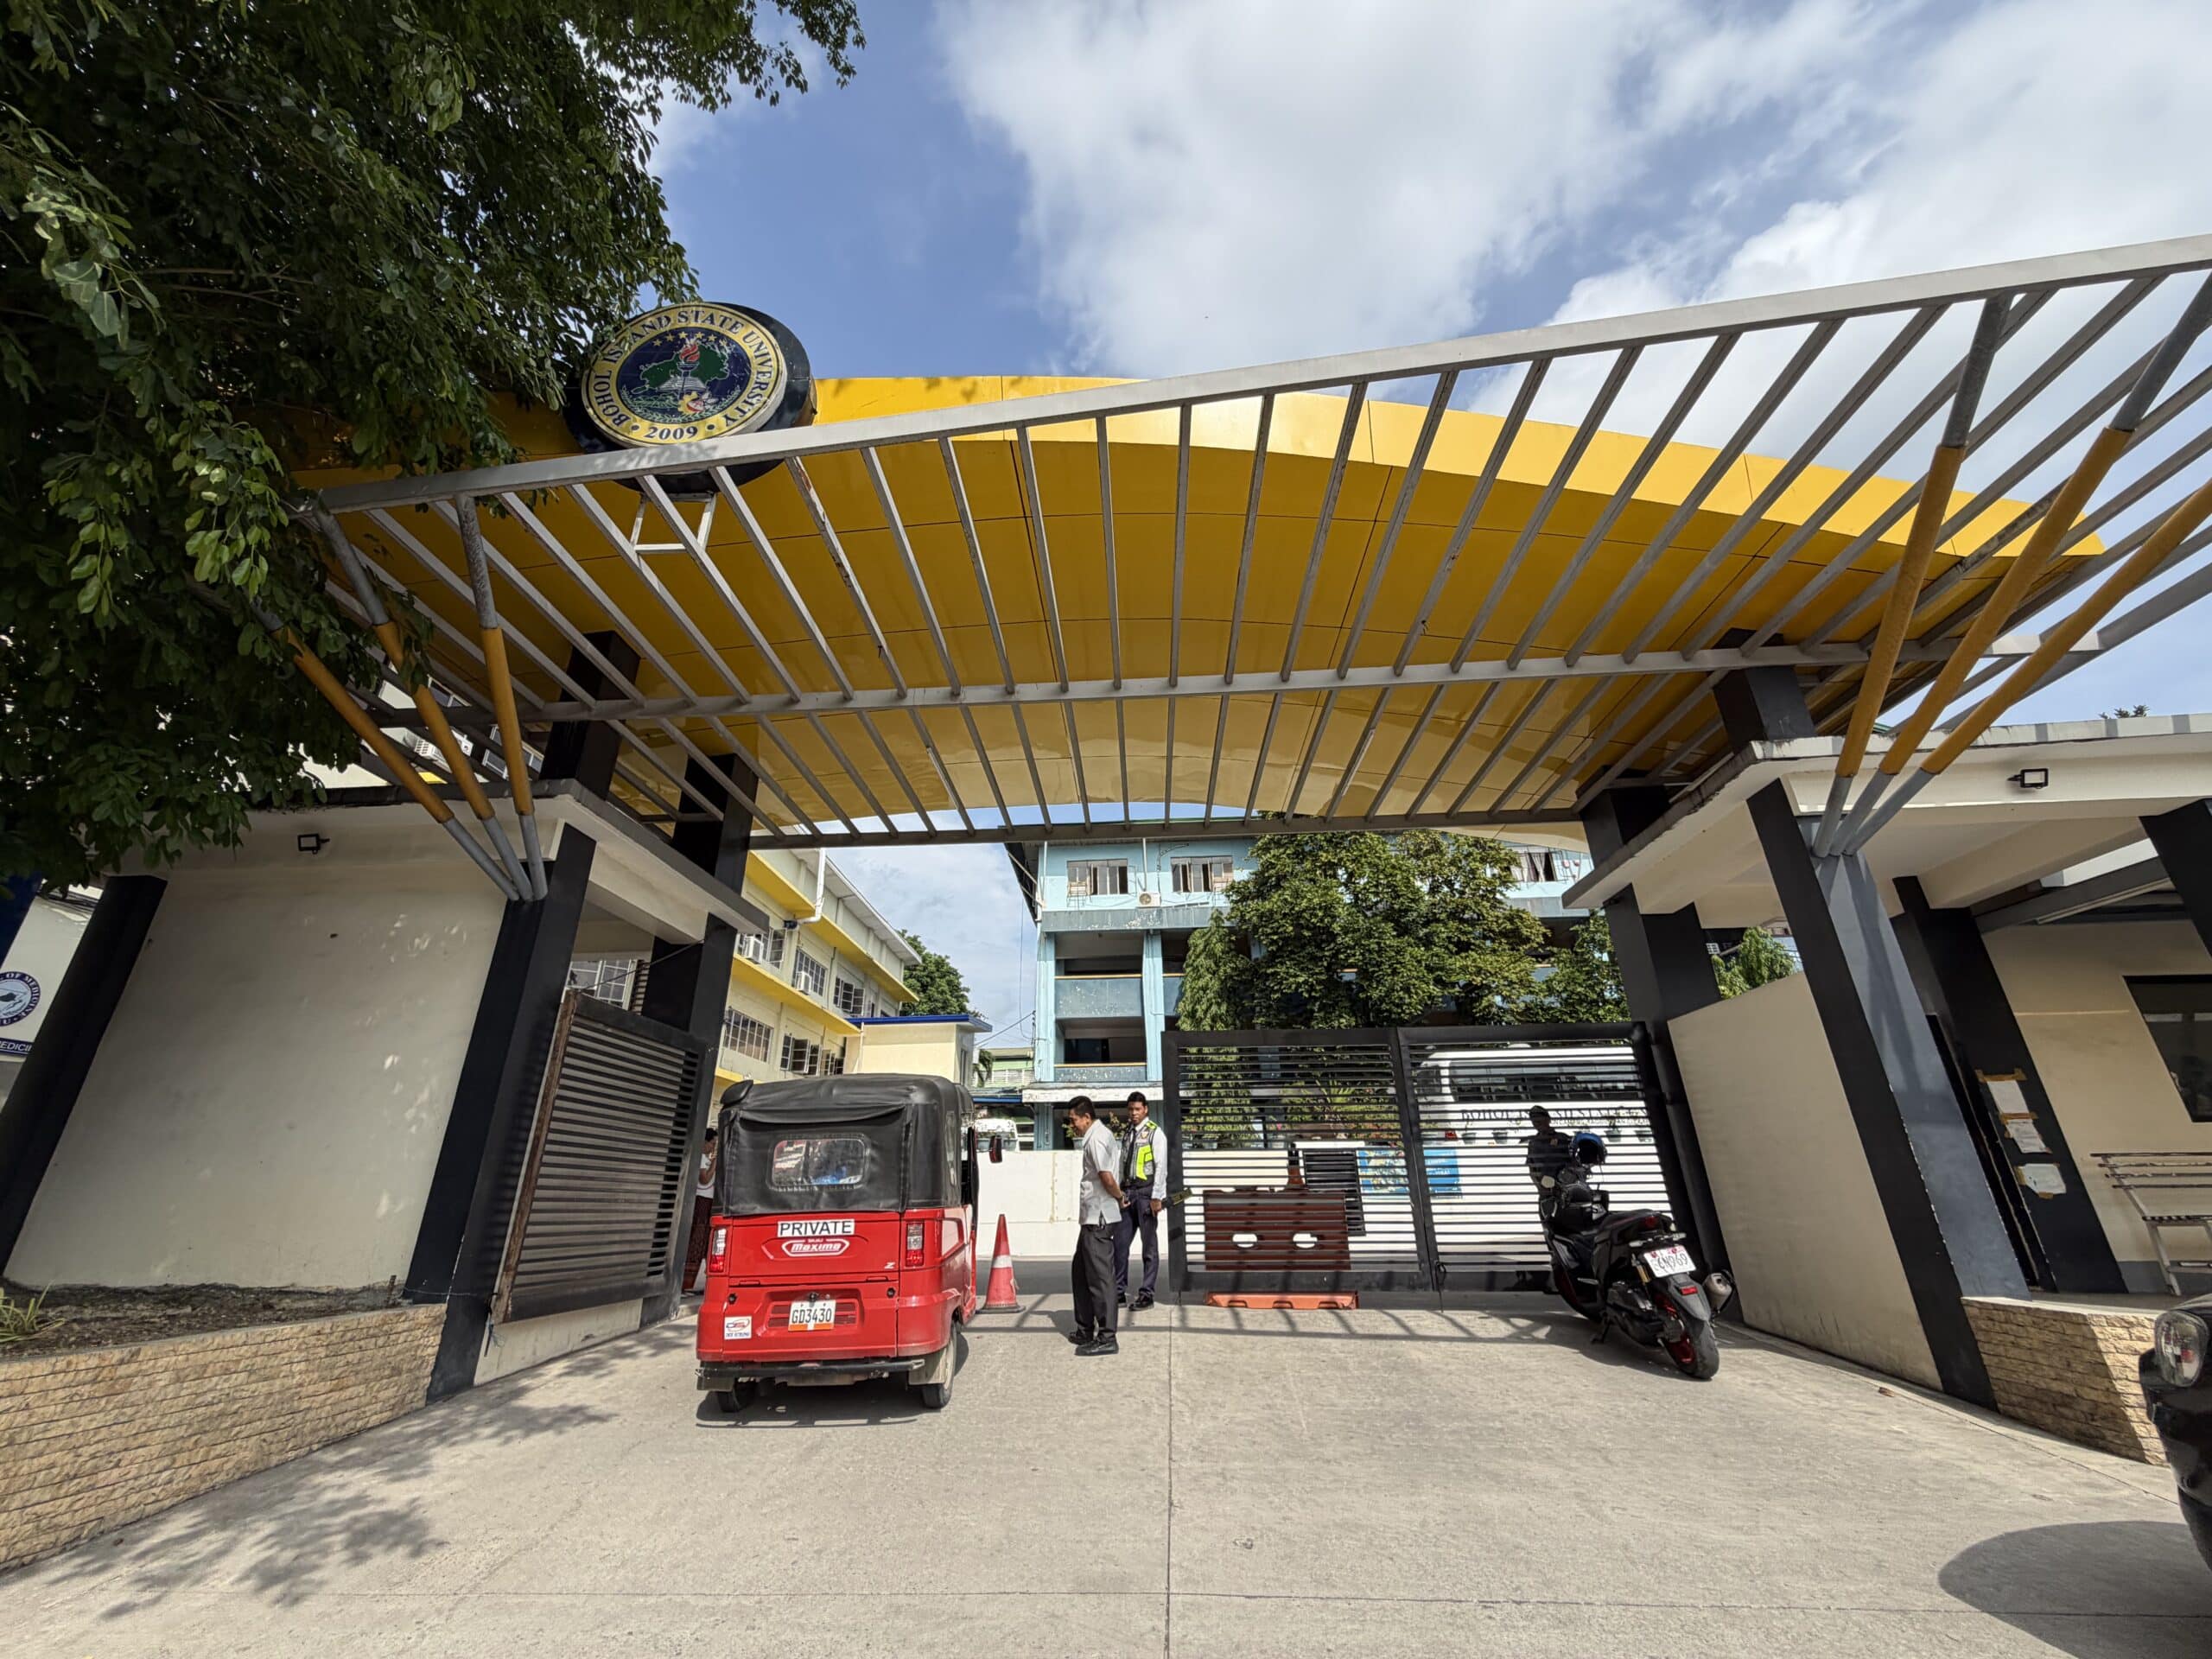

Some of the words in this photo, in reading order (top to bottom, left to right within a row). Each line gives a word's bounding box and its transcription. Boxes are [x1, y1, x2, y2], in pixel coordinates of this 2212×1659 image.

[677, 309, 745, 334] STATE
[611, 314, 672, 365] ISAND
[725, 330, 772, 428] UNIVERSITY
[593, 370, 631, 427] BOHOL
[644, 425, 699, 440] 2009
[779, 1220, 853, 1236] PRIVATE
[791, 1308, 832, 1324] GD3430
